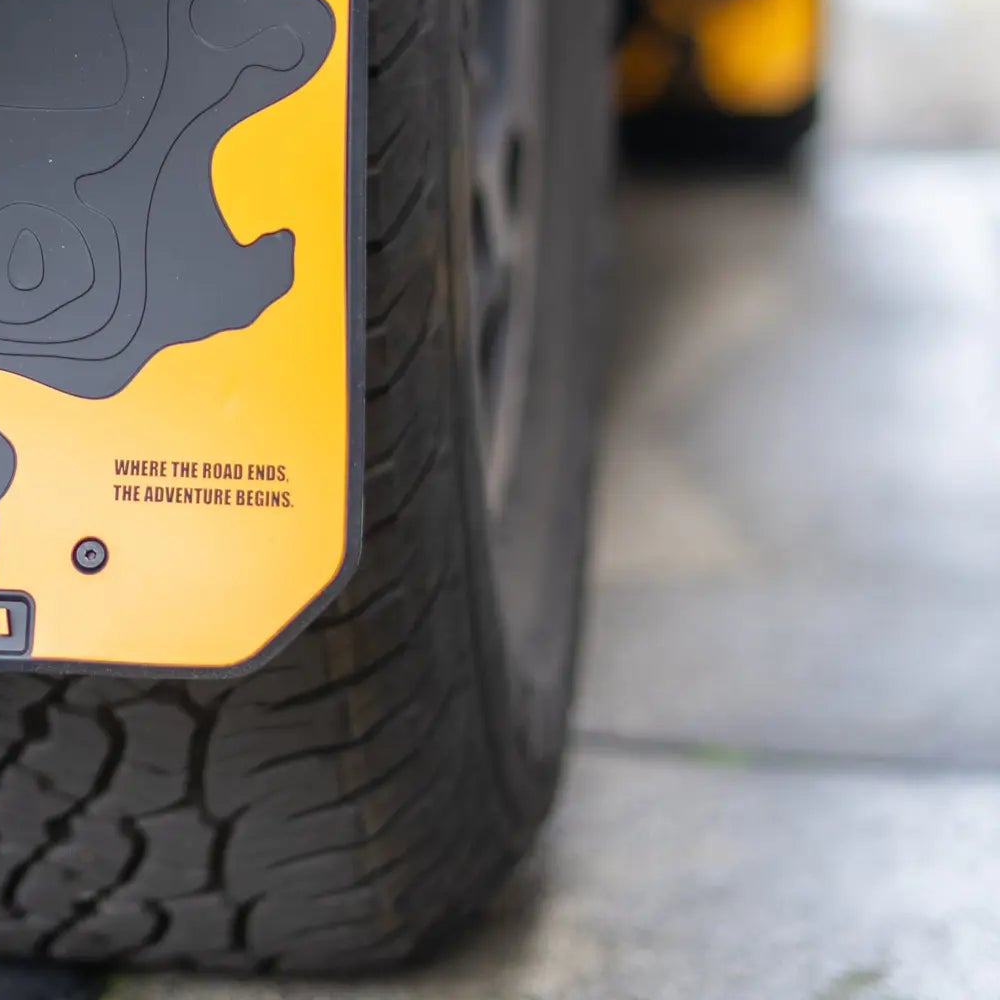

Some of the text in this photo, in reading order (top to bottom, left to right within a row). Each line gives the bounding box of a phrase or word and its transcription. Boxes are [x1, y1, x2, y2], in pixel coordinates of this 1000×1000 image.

[114, 459, 167, 477] WHERE
[171, 461, 198, 478] THE
[202, 463, 243, 480] ROAD
[113, 485, 294, 508] THE ADVENTURE BEGINS.
